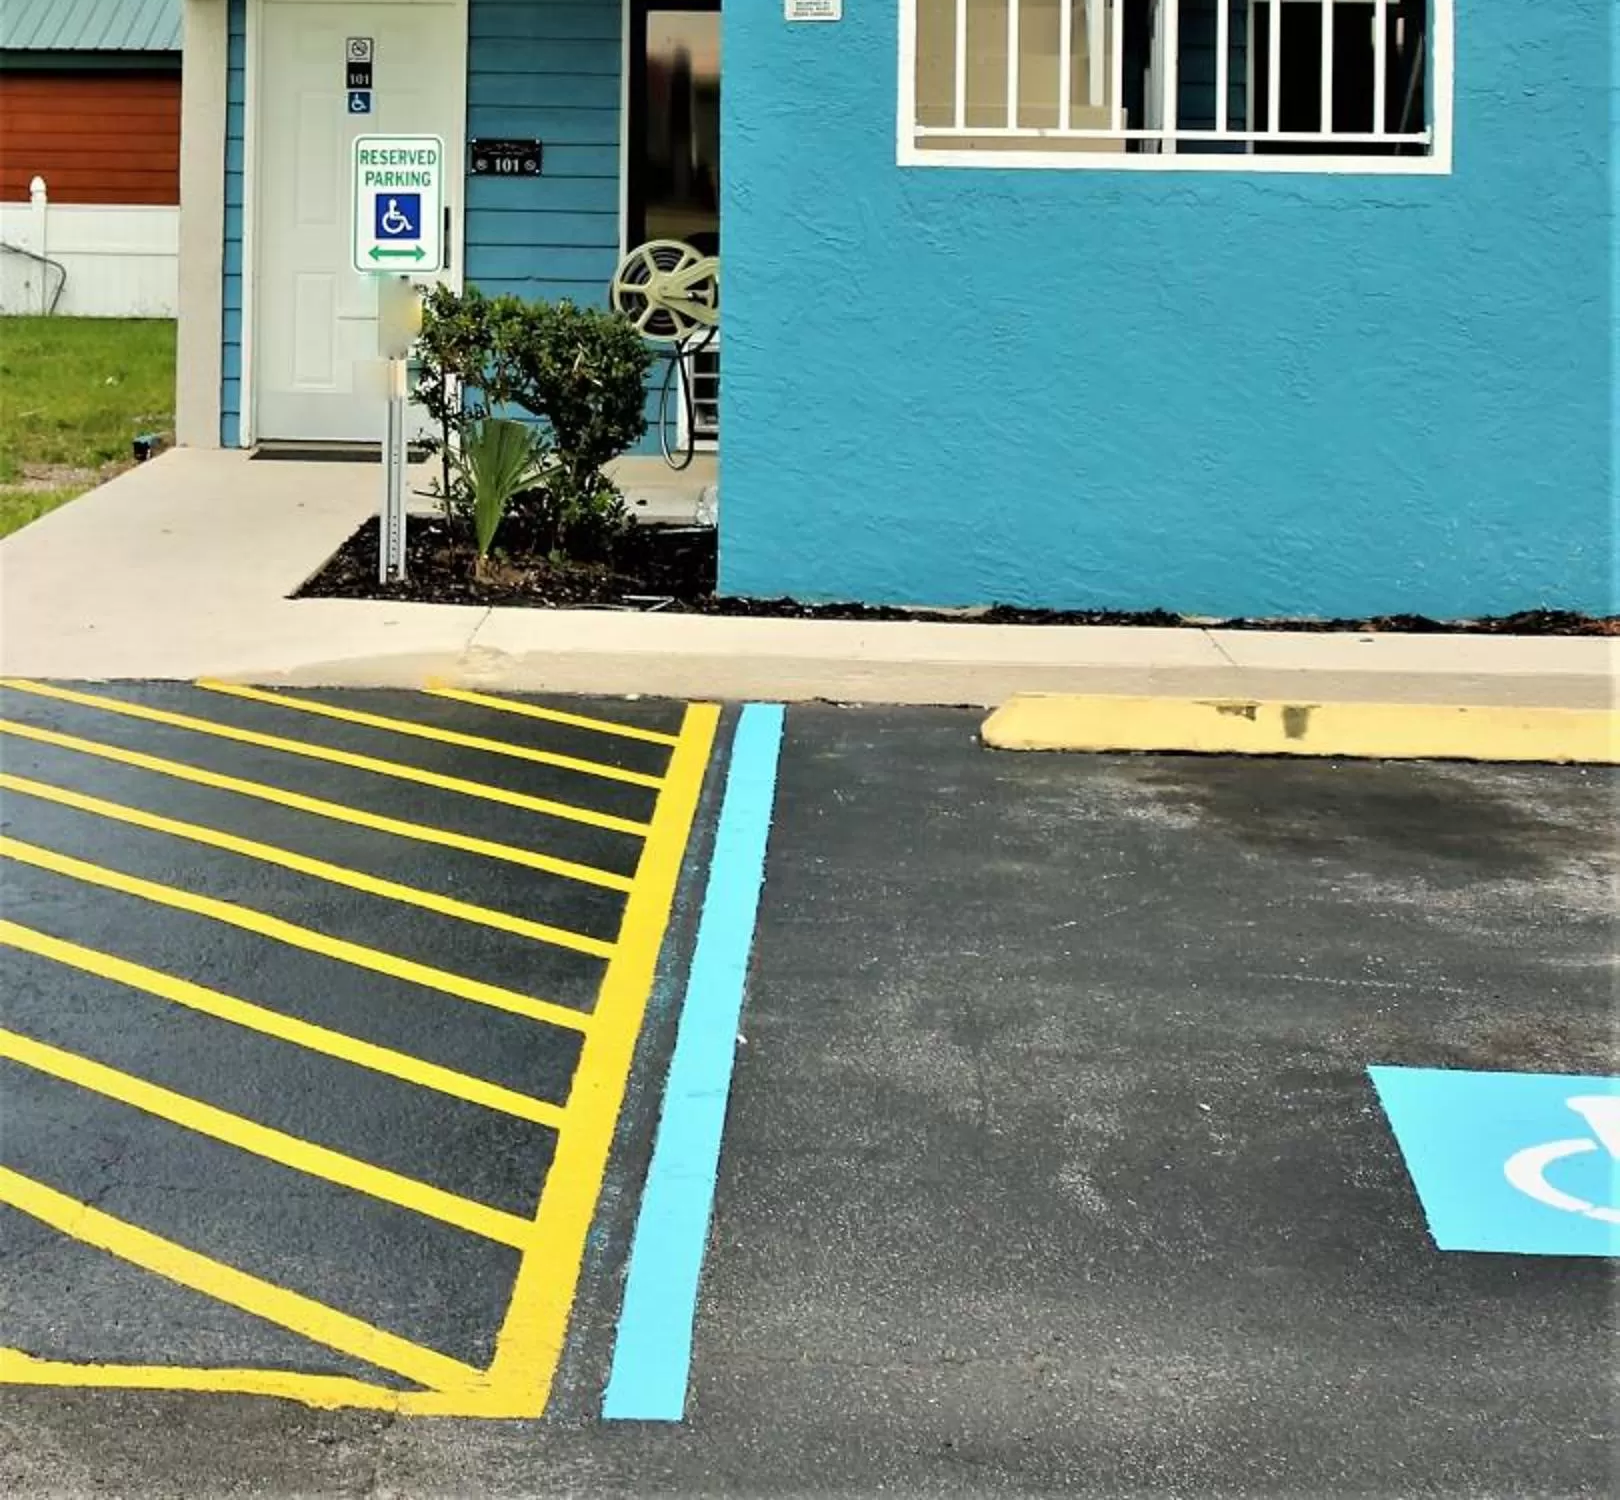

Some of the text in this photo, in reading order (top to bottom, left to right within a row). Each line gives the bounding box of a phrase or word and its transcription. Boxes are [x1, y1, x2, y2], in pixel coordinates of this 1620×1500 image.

[349, 73, 370, 85] 101
[359, 148, 437, 166] RESERVED
[494, 157, 520, 173] 101
[364, 170, 432, 188] PARKING
